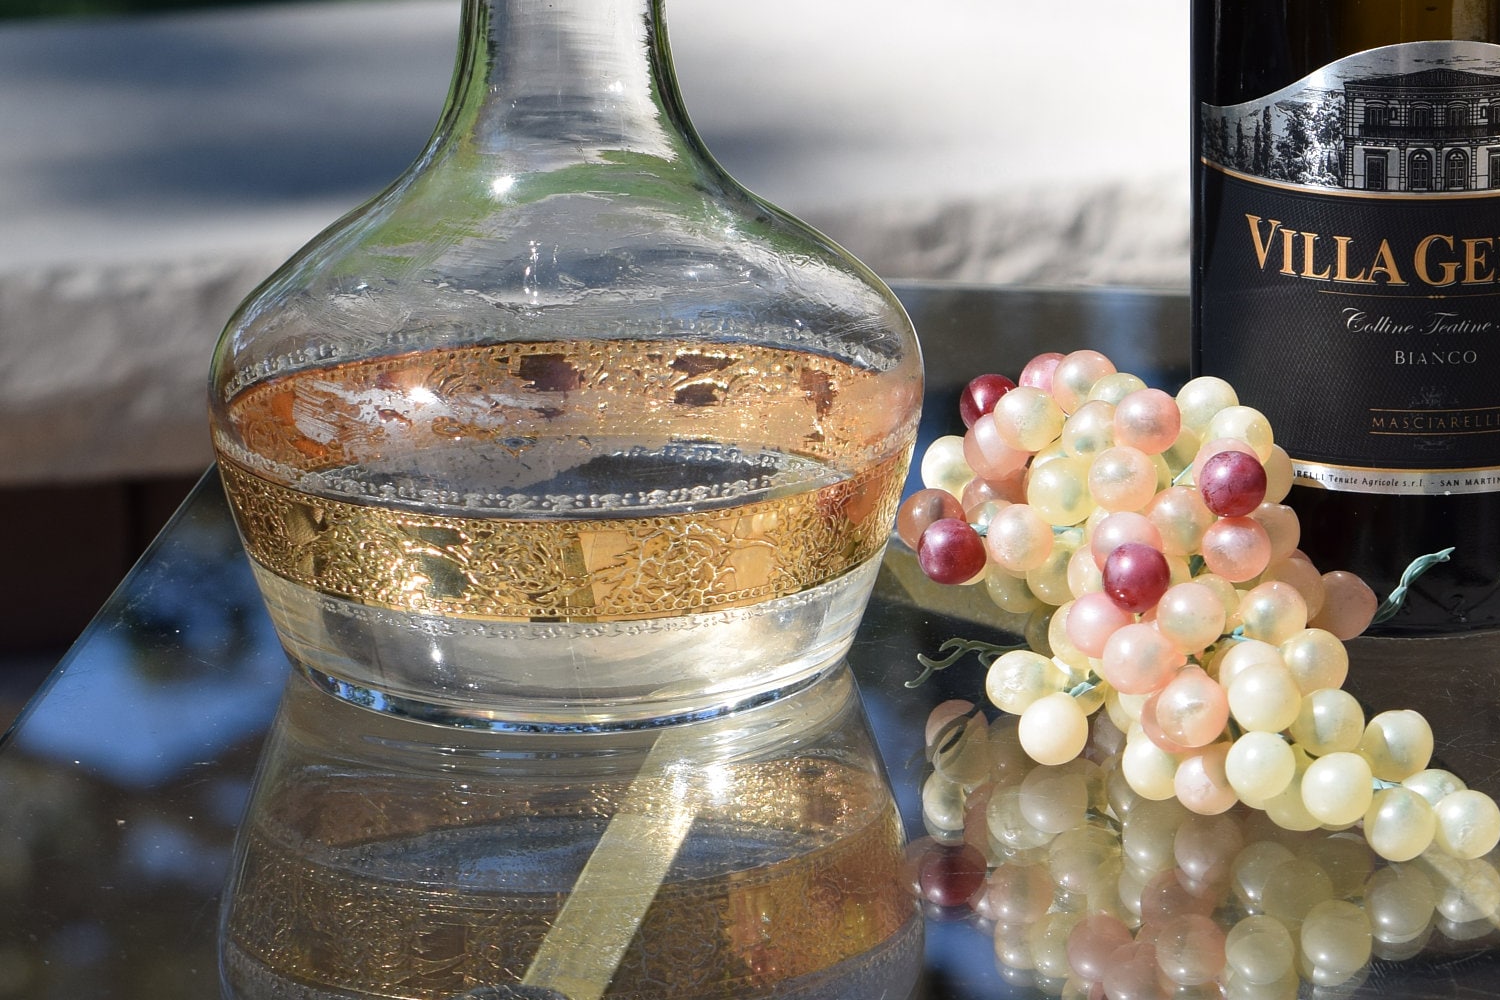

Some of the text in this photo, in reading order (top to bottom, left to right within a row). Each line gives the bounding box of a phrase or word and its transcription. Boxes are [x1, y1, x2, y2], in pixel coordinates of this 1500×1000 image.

[1245, 213, 1408, 287] VILLA
[1342, 307, 1414, 334] Colline
[1420, 312, 1492, 335] Teatine
[1394, 350, 1478, 366] BIANCO
[1328, 474, 1358, 486] Tenute
[1361, 477, 1399, 488] Agricole
[1440, 478, 1460, 488] SAN
